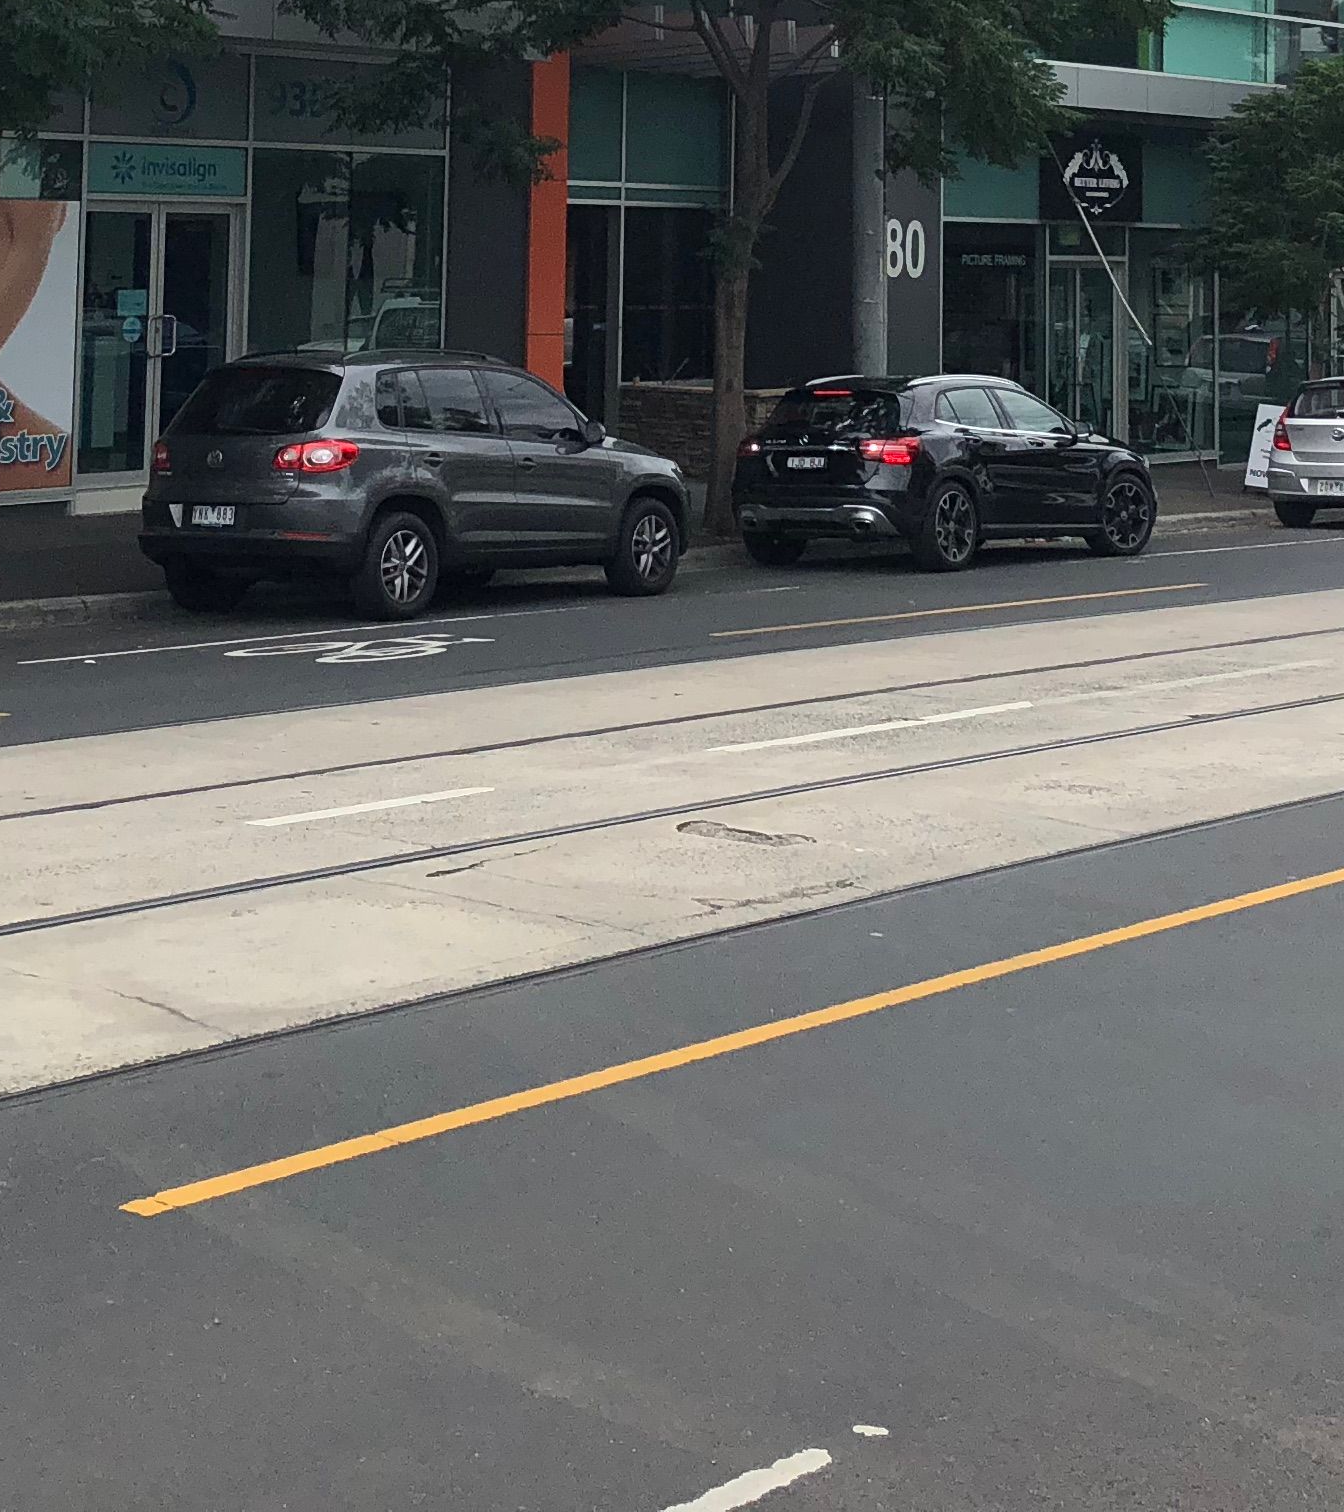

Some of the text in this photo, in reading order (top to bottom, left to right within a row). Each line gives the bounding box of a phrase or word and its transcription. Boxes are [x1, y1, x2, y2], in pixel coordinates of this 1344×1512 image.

[141, 155, 217, 182] invisalign
[886, 218, 925, 278] 80
[961, 254, 1026, 266] PICTURE FRAMING
